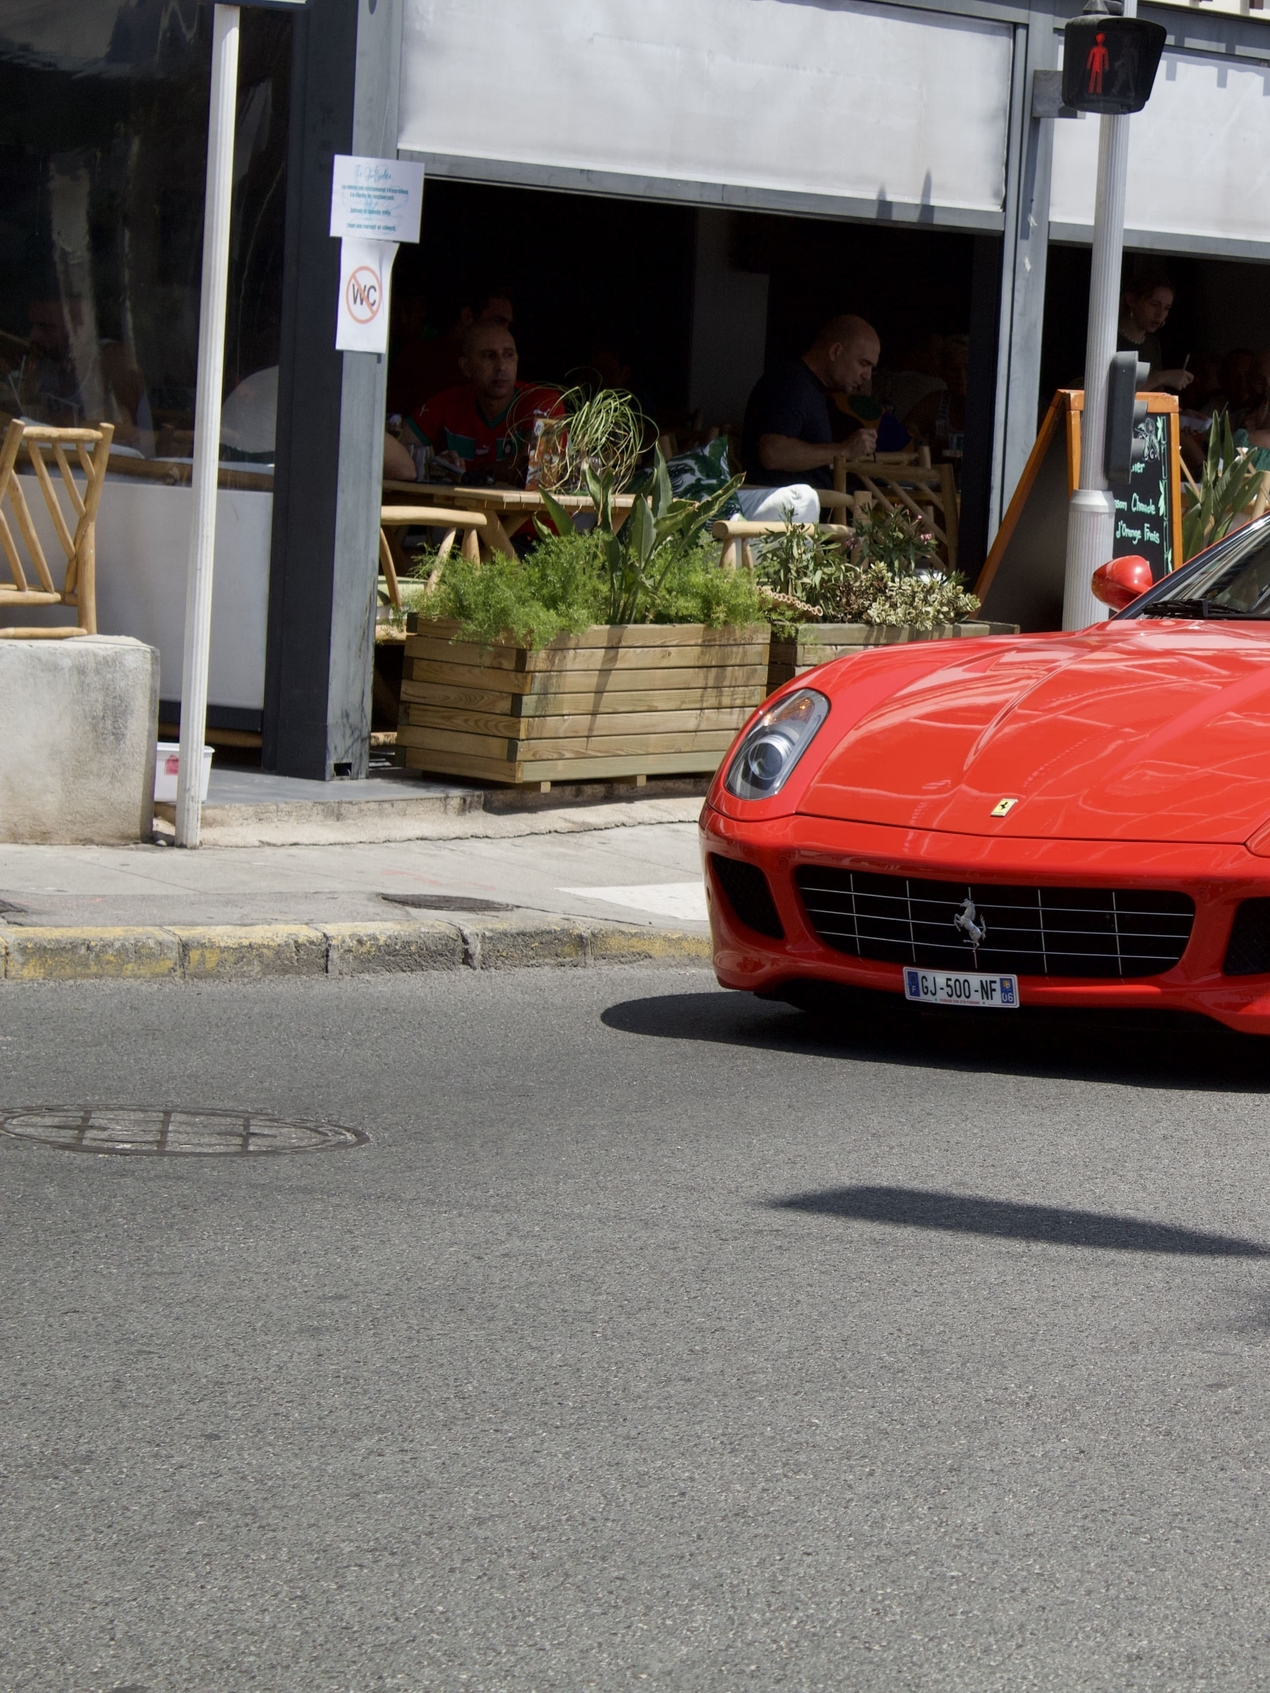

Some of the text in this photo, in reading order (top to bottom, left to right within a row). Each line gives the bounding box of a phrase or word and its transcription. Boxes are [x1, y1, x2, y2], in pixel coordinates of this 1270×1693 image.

[352, 283, 377, 307] WC
[921, 975, 997, 1001] GJ-500-NF
[1001, 992, 1014, 1003] 06
